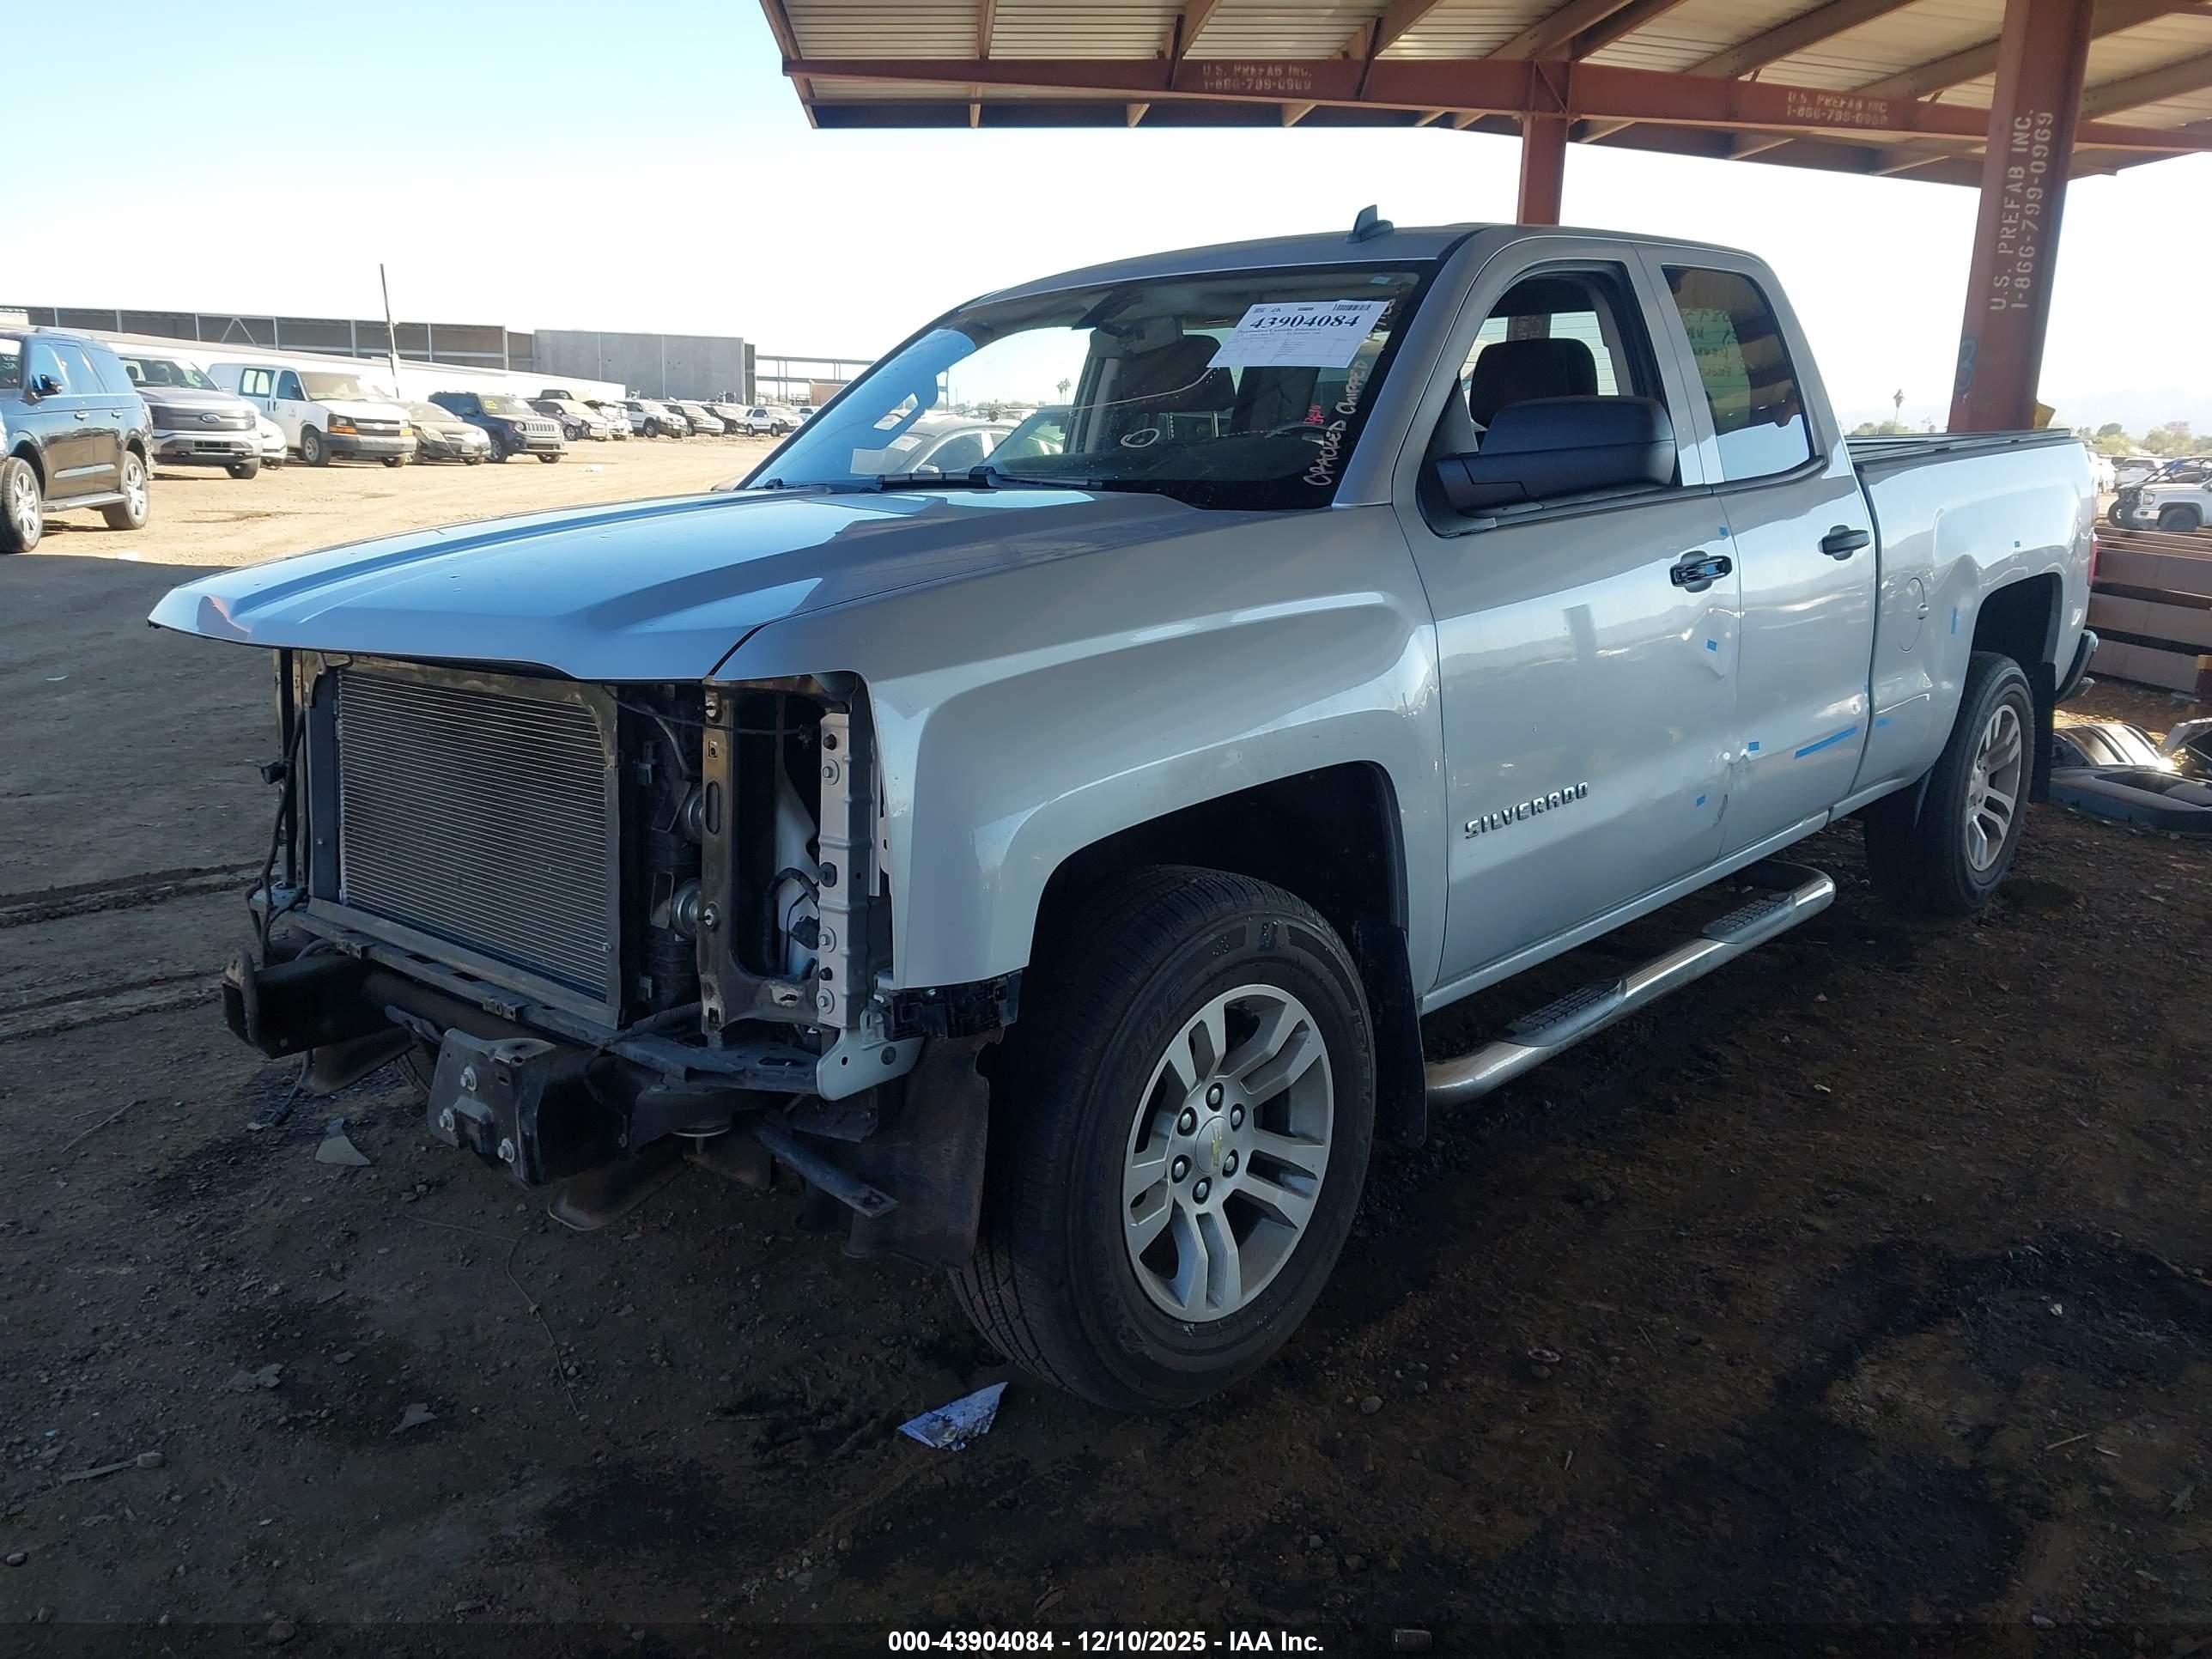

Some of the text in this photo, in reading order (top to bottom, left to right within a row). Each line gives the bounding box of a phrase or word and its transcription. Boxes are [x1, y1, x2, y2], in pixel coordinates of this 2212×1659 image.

[1990, 109, 2033, 310] U.S. PREFAB INC.
[2011, 112, 2053, 308] 1-866-799-0969
[1250, 315, 1360, 328] 43904084
[1464, 781, 1589, 839] SILVERADO
